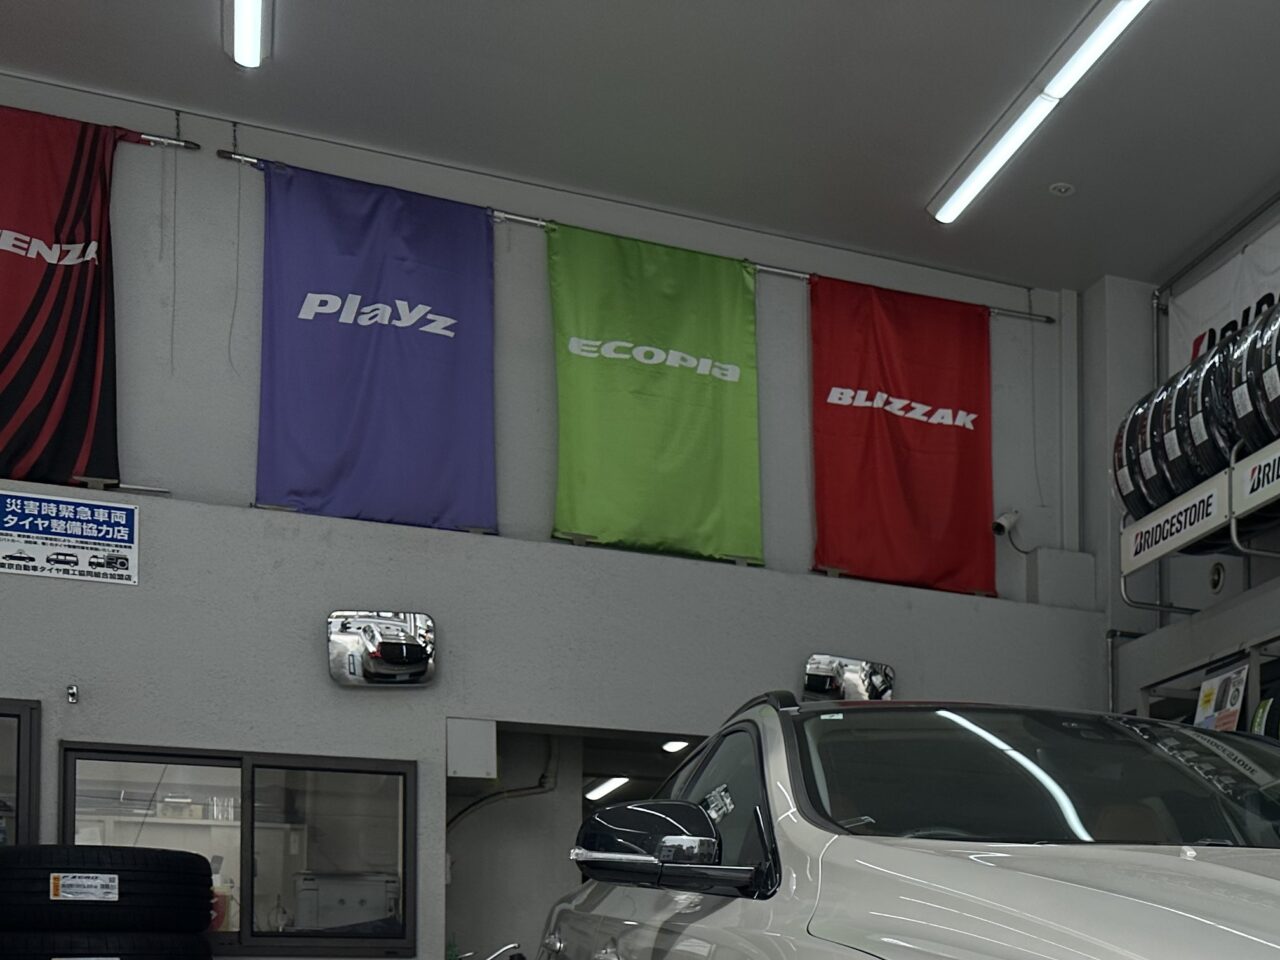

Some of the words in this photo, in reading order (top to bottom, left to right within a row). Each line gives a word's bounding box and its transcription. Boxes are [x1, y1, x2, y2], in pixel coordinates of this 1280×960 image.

[826, 387, 979, 430] BLIZZAK
[3, 514, 130, 541] タイヤ整備協力店
[6, 498, 127, 525] 災害時緊急車両
[1134, 494, 1213, 557] BRIDGESTONE
